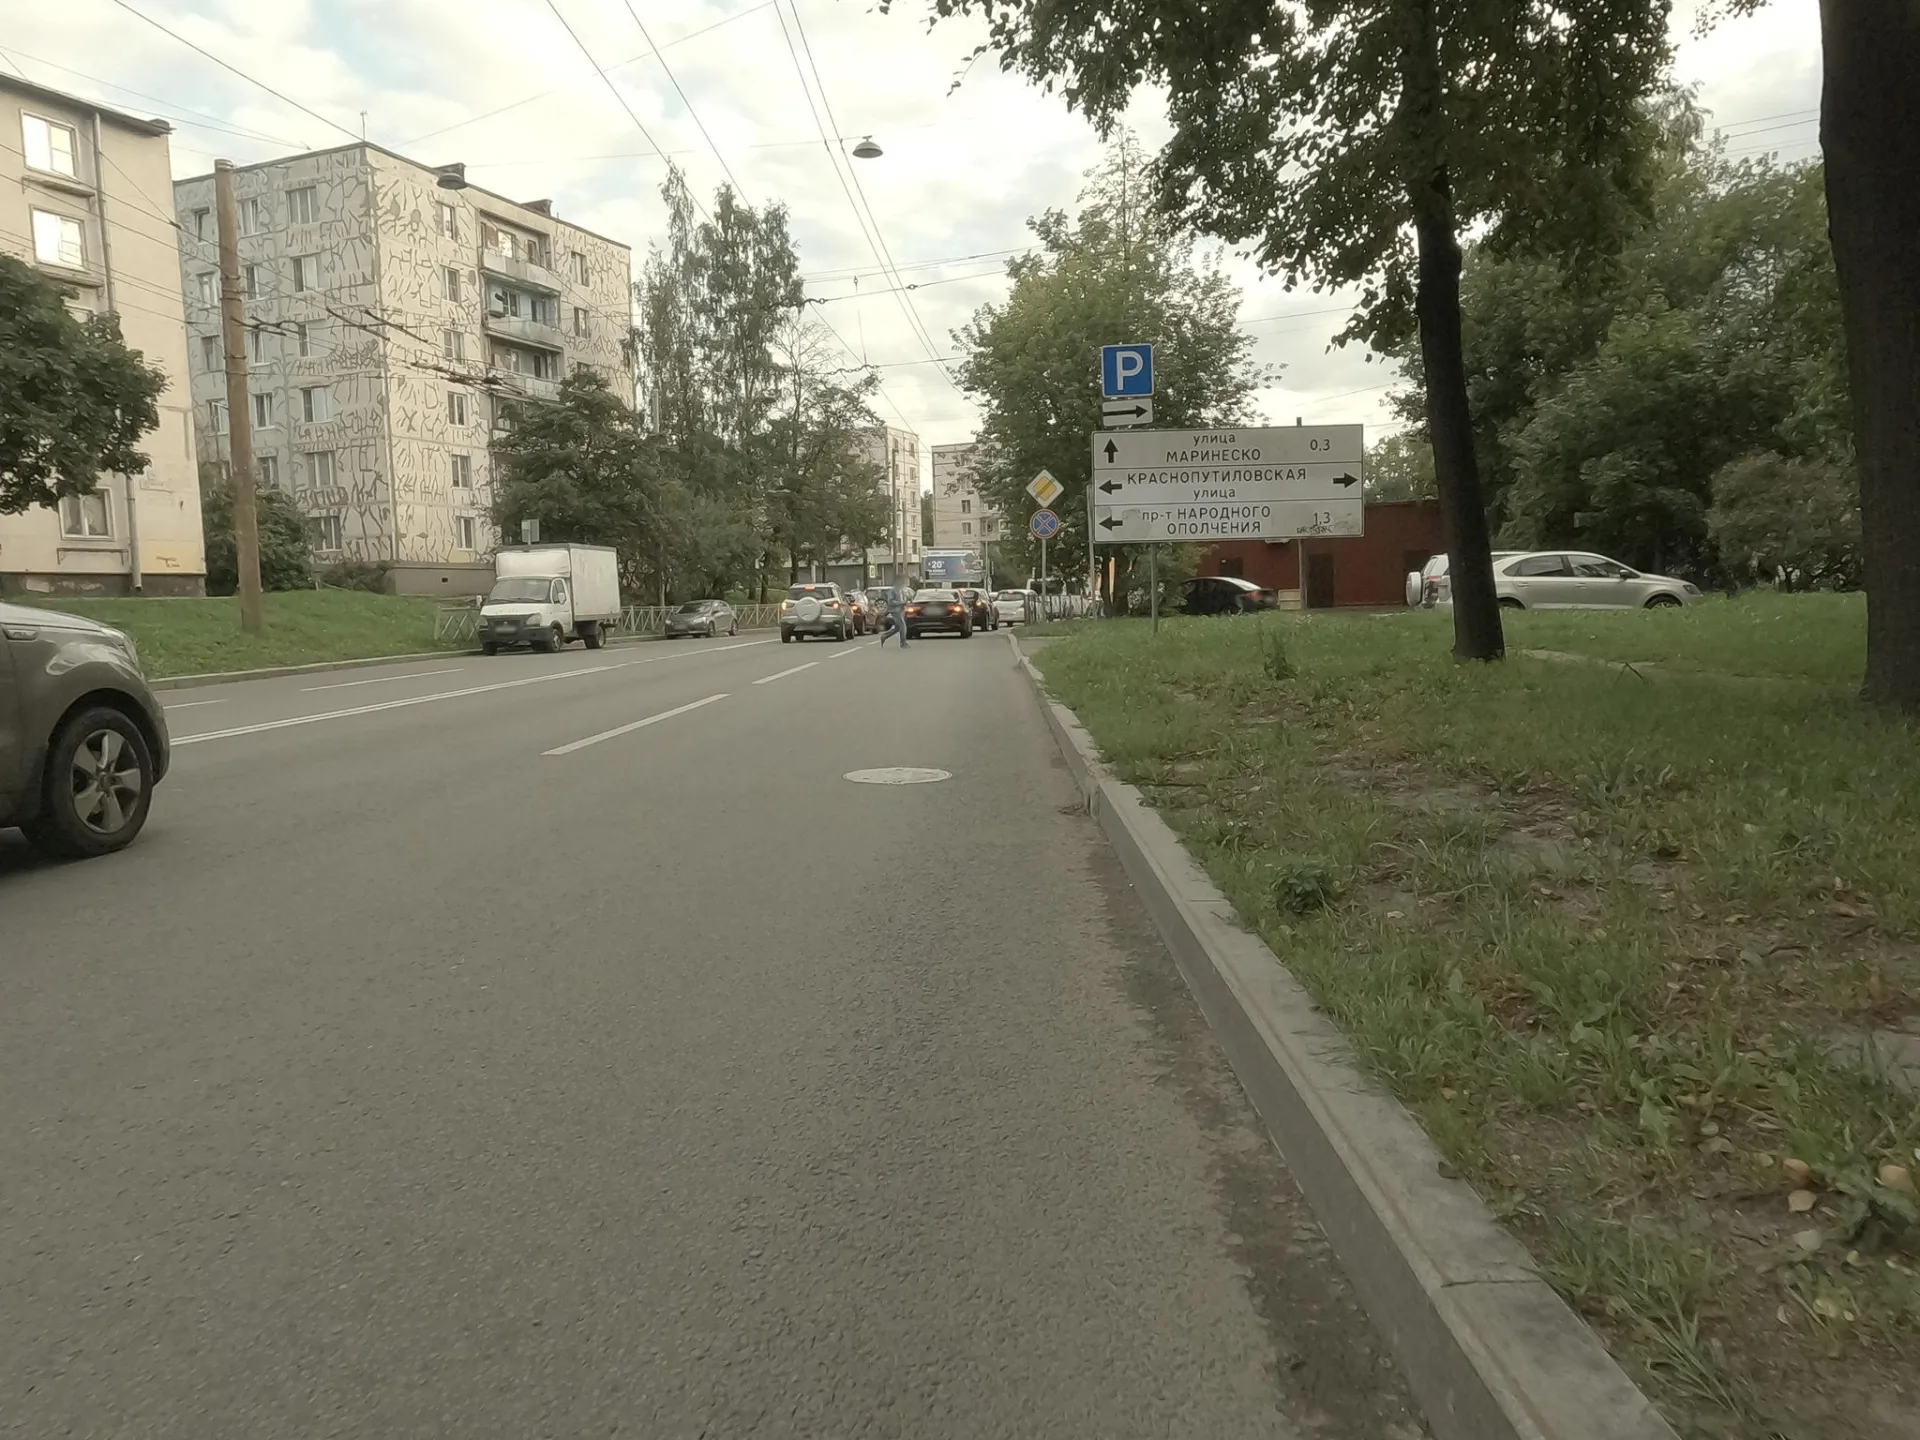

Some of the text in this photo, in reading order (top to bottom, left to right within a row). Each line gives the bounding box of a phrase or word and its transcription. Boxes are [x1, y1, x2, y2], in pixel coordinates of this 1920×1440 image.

[1116, 351, 1143, 391] P
[1193, 434, 1236, 447] улица
[1166, 449, 1261, 463] МАРИНЕСКО
[1127, 468, 1307, 485] КРАСНОПУТИЛОВСКАЯ
[1193, 488, 1236, 501] улица
[1142, 506, 1271, 523] пр-т НАРОДНОГО
[1313, 511, 1331, 525] 1,3
[1166, 521, 1262, 535] ОПОЛЧЕНИЯ
